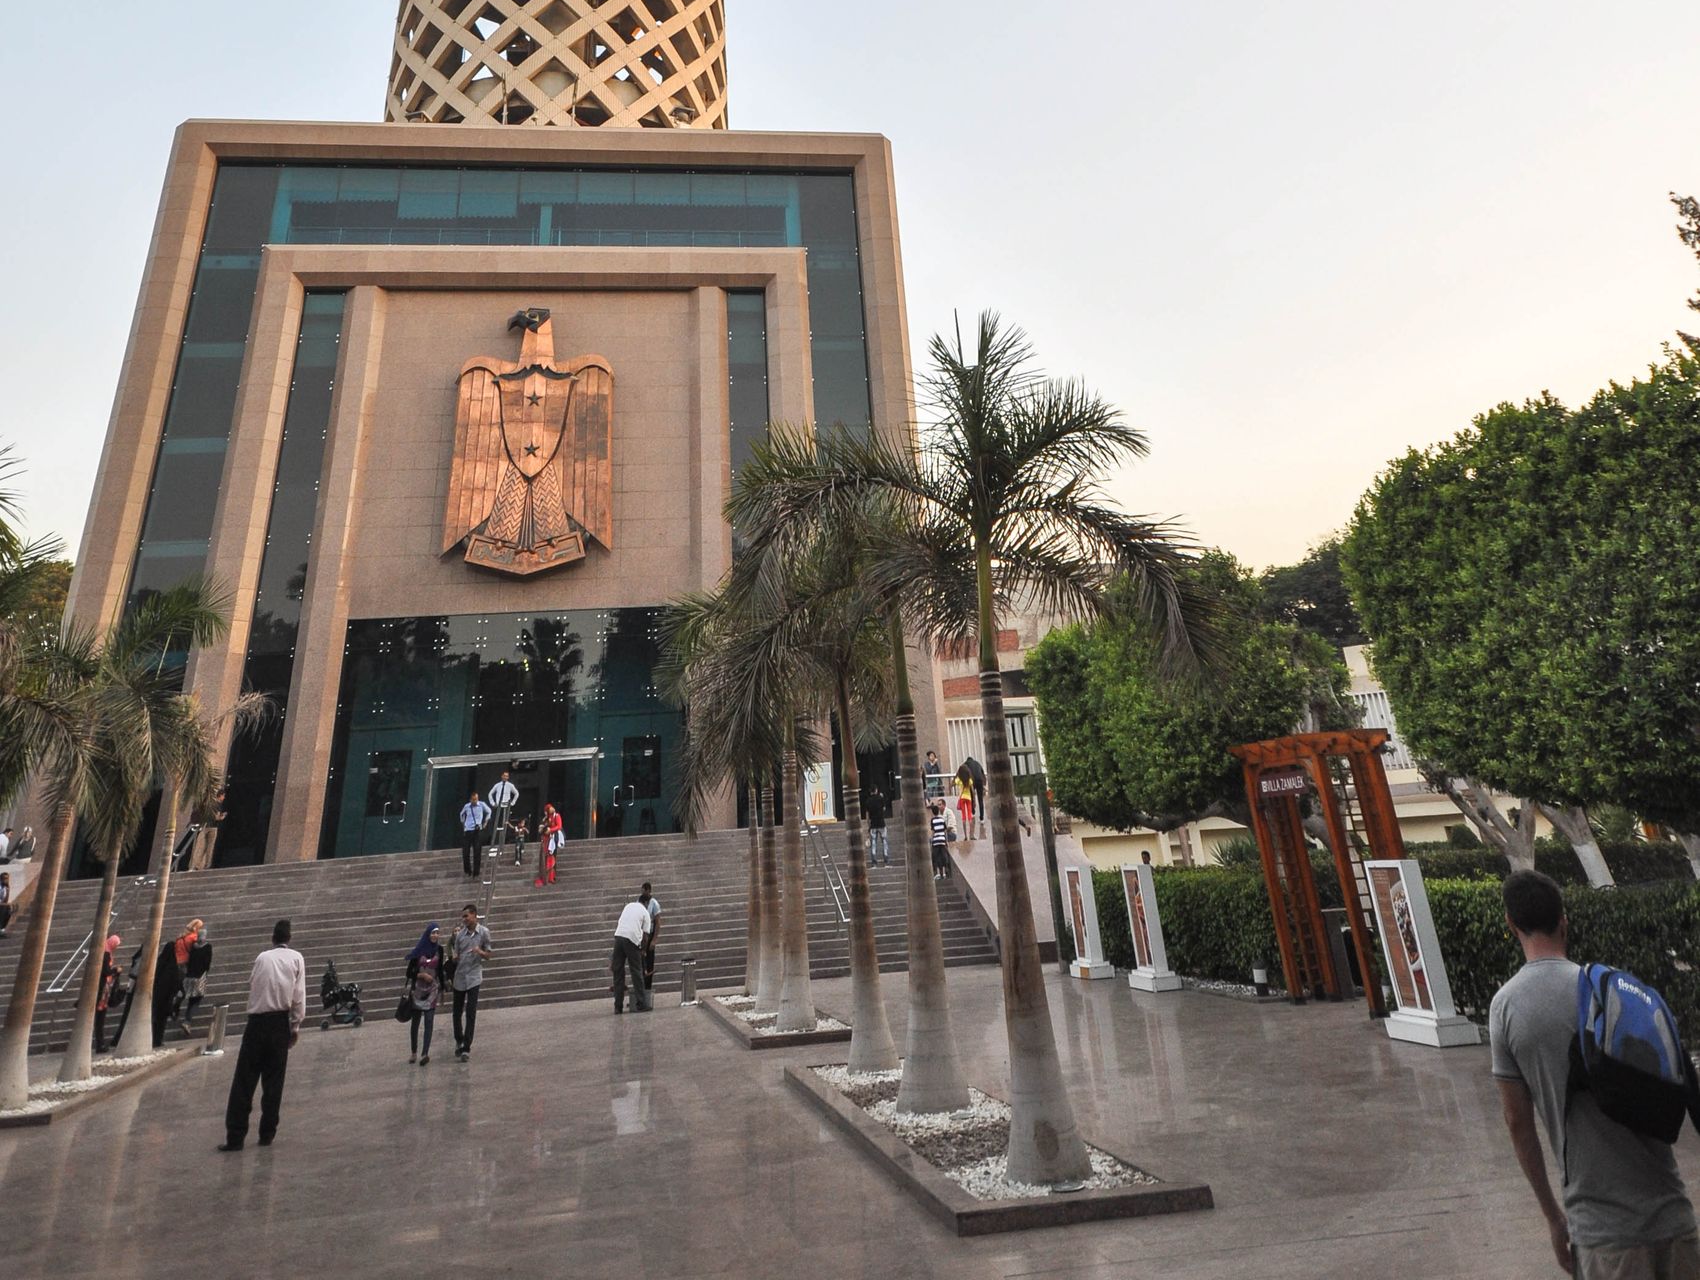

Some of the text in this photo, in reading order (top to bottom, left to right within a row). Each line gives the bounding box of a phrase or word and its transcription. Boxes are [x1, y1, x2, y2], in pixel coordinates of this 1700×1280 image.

[1267, 776, 1305, 792] VILLA ZAMALEK
[809, 791, 828, 816] VIP
